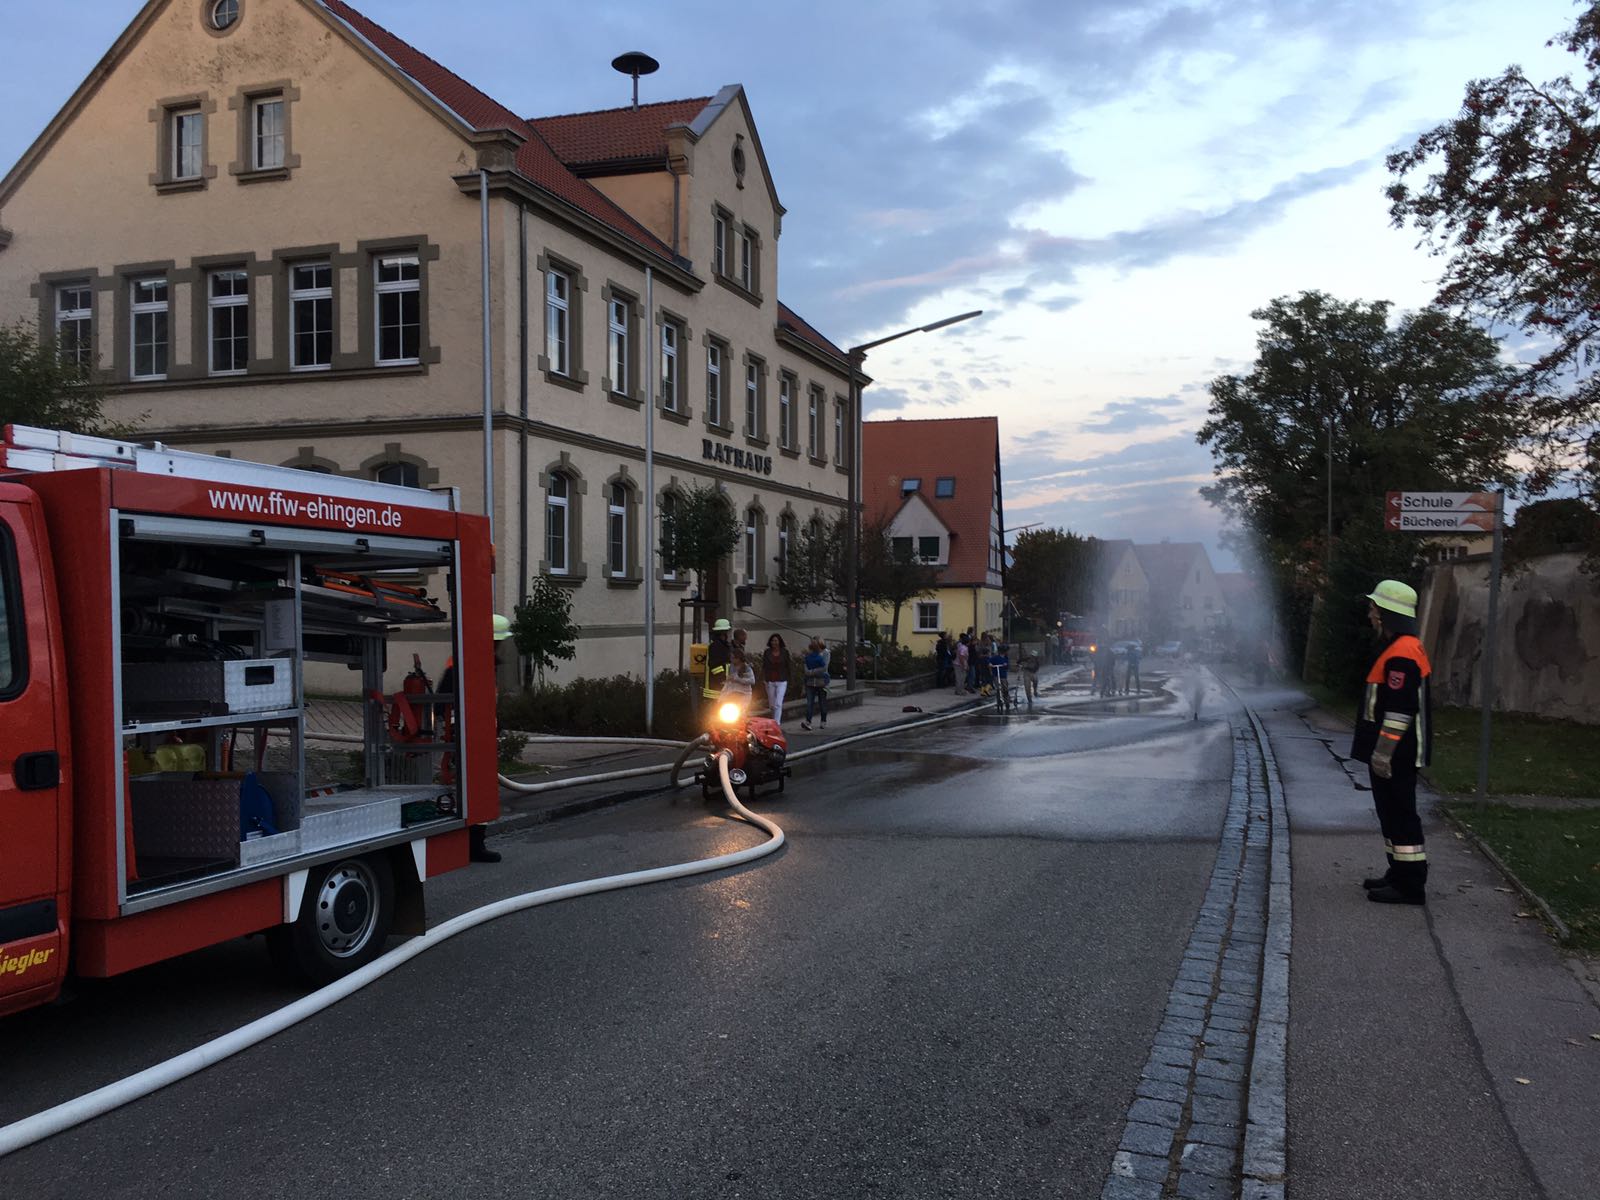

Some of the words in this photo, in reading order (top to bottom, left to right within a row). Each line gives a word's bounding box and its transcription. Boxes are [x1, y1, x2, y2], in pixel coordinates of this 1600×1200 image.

[702, 438, 772, 476] RATHAUS
[208, 489, 402, 528] www.ffw-ehingen.de
[1403, 496, 1454, 508] Schule
[1402, 515, 1459, 527] Bücherei
